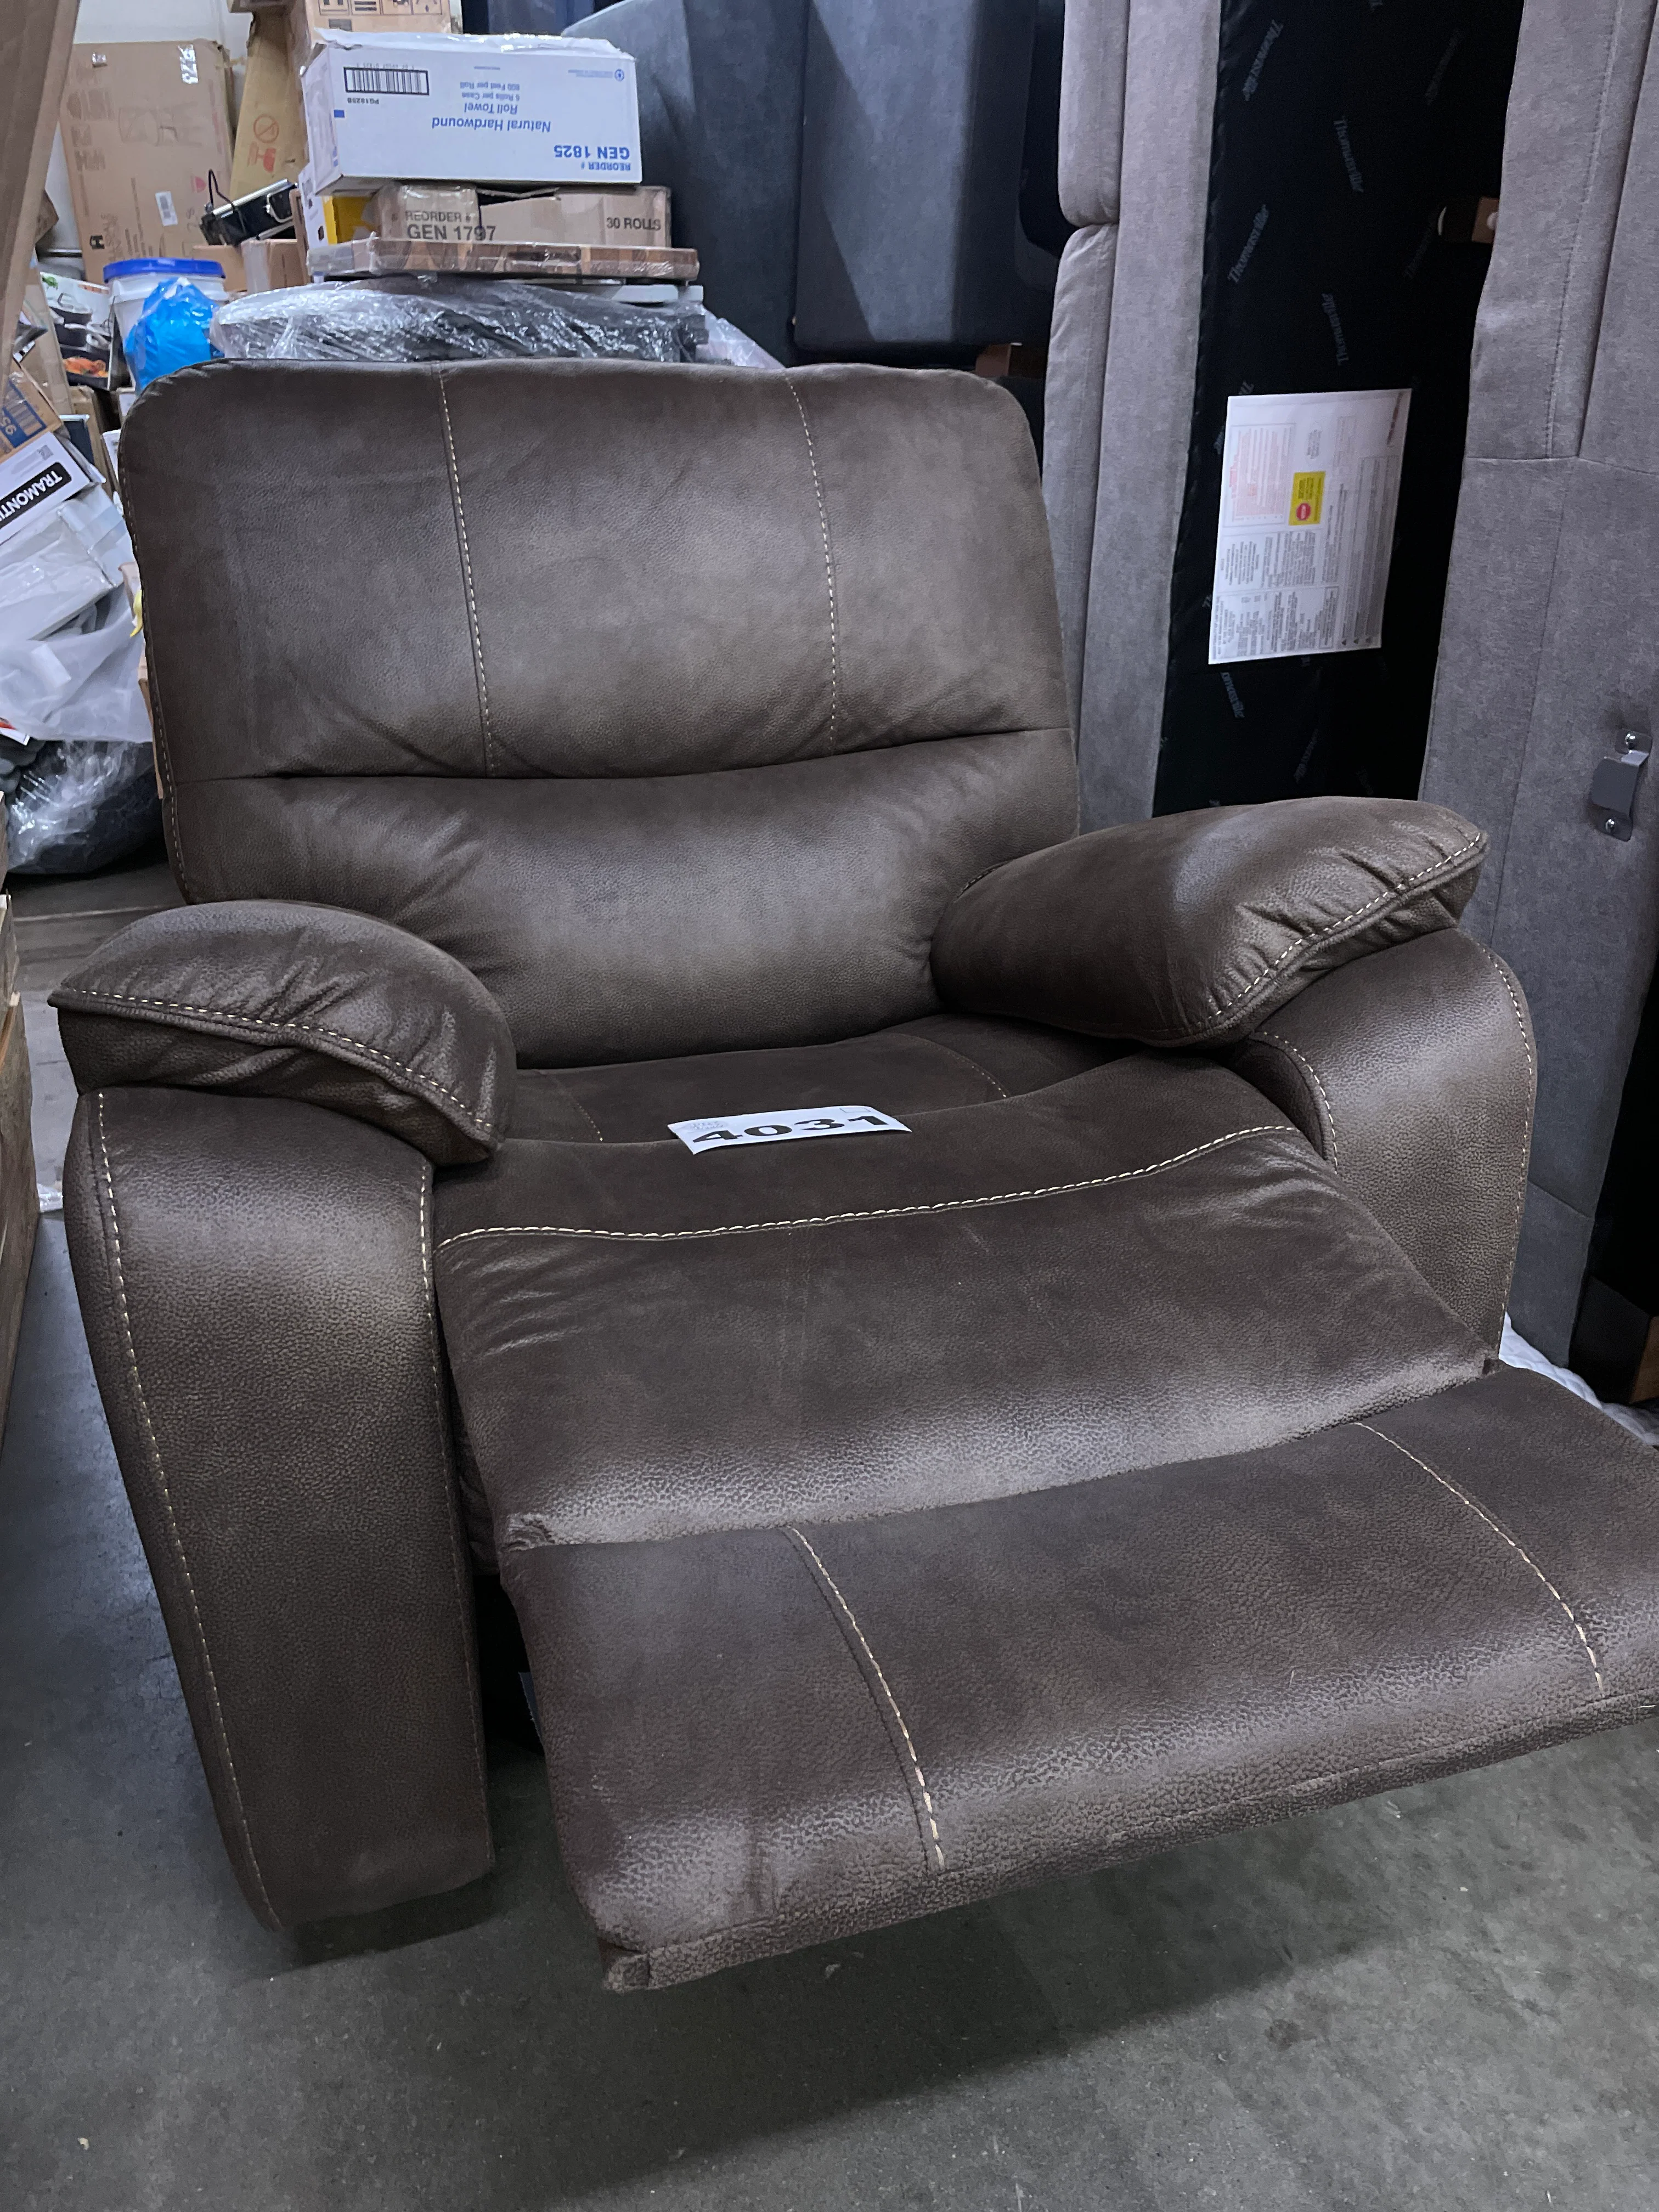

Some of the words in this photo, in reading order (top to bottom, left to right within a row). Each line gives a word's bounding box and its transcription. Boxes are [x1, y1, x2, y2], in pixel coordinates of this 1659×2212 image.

[464, 102, 494, 114] Towel
[496, 103, 518, 115] Roll
[431, 117, 503, 131] Hardwound
[507, 120, 551, 133] Natural
[553, 144, 591, 159] 1825
[597, 146, 630, 160] GEN
[588, 161, 631, 171] REORDER
[405, 210, 461, 222] REORDER
[606, 216, 620, 229] 30
[624, 217, 661, 231] ROLLS
[407, 224, 447, 240] GEN
[454, 225, 496, 241] 1797
[0, 470, 63, 522] TRAMONTI
[692, 1115, 890, 1143] 4031
